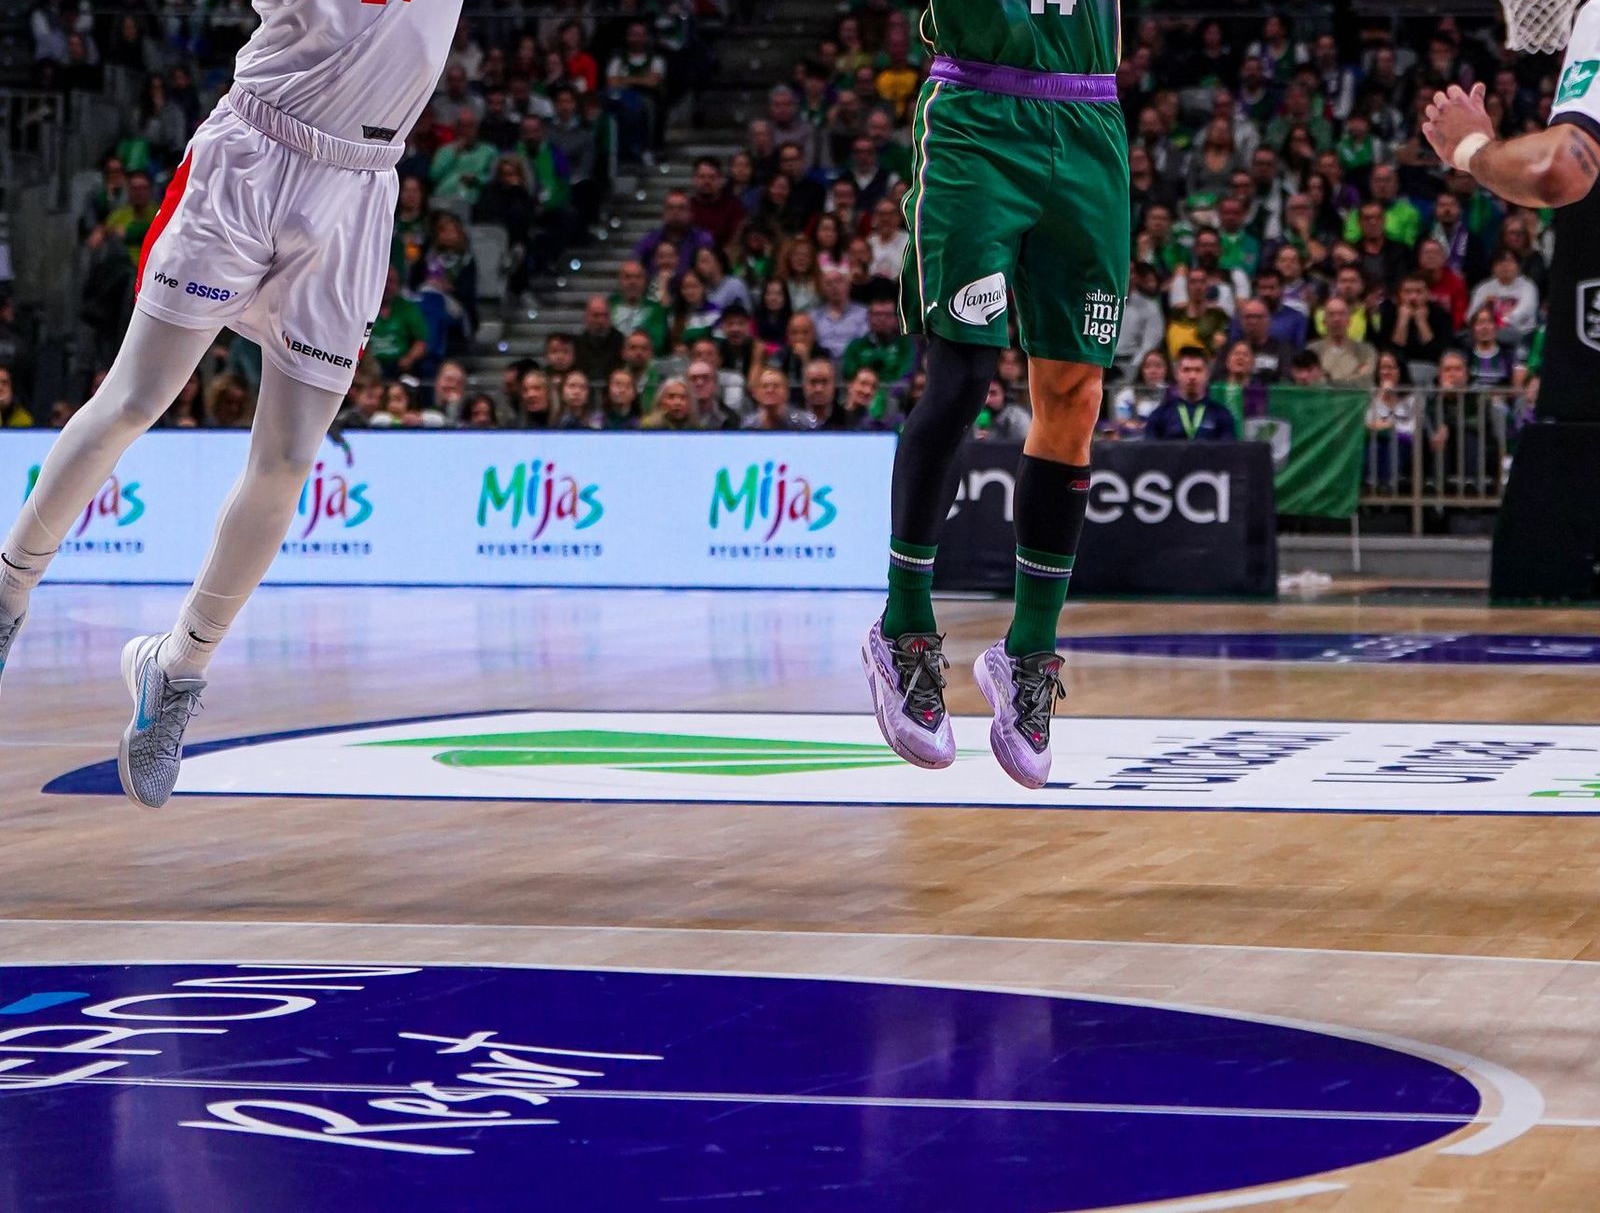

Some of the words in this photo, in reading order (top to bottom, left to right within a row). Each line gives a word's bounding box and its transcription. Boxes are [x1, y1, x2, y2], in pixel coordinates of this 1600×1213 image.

[153, 271, 179, 289] vive
[185, 281, 231, 302] asisa
[1085, 289, 1116, 303] sabor
[1084, 303, 1091, 312] a
[290, 341, 353, 369] BERNER
[477, 458, 604, 541] Mijas
[708, 459, 838, 543] Mijas
[476, 541, 603, 558] AYUNTAMIENTO
[708, 543, 837, 560] AYUNTAMIENTO
[178, 1031, 664, 1156] Resort
